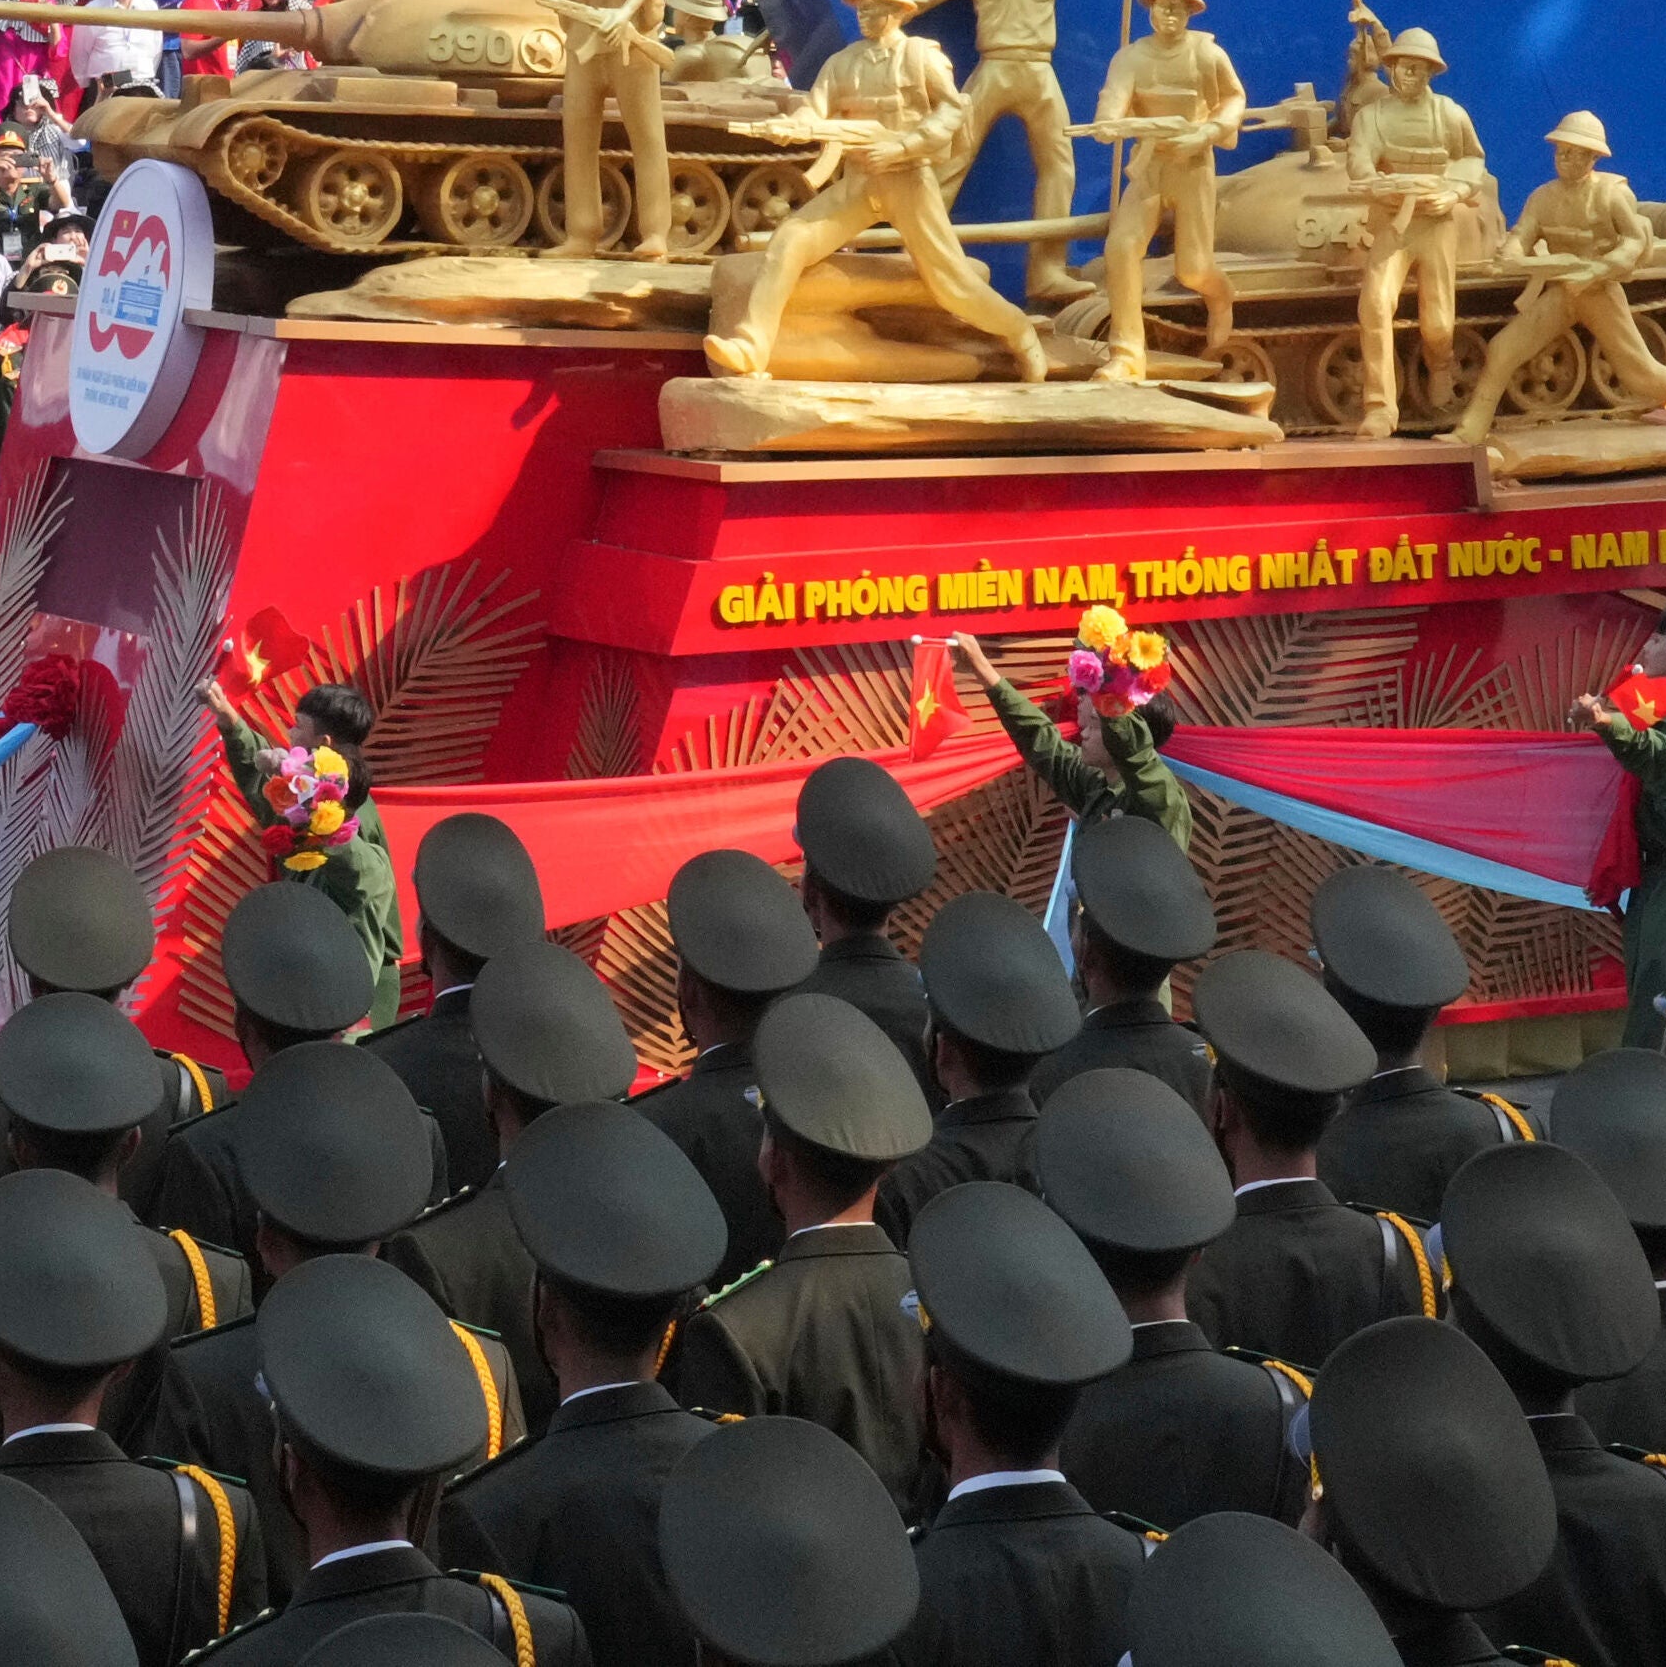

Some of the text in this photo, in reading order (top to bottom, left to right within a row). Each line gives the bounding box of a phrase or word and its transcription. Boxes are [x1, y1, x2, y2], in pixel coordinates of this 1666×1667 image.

[428, 29, 514, 65] 390
[719, 572, 795, 624] GIẢI
[804, 569, 929, 618] PHÓNG
[937, 558, 1023, 611] MIỀN
[1033, 563, 1125, 609] NAM,
[1129, 545, 1251, 598] THỐNG
[1258, 538, 1358, 590] NHẤT
[1369, 533, 1438, 583] ĐẤT
[1447, 531, 1542, 578] NƯỚC
[1571, 530, 1650, 570] NAM
